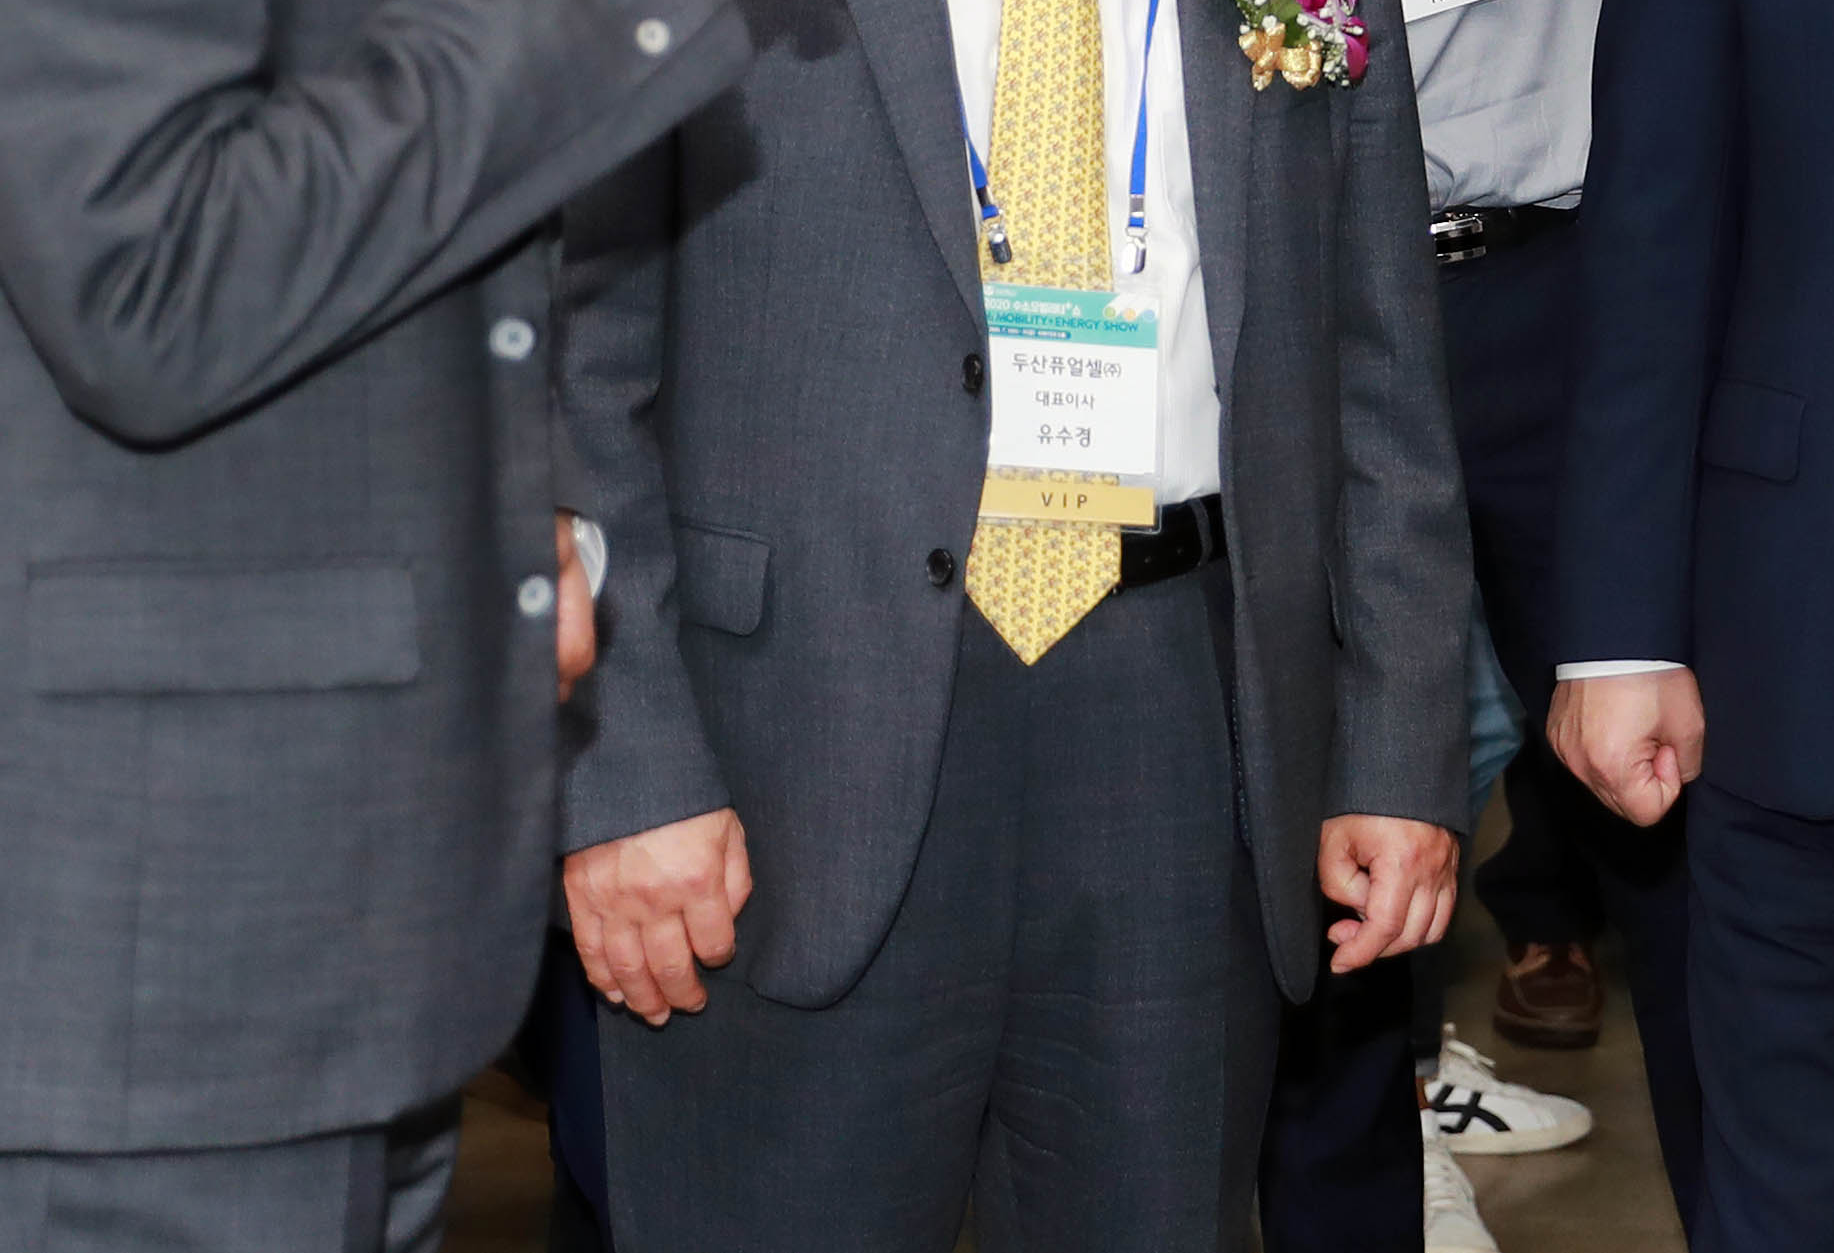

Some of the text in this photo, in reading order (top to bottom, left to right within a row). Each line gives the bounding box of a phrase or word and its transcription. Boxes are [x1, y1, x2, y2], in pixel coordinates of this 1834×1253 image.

[1104, 321, 1139, 333] SHOW
[1036, 390, 1095, 410] 대표이사
[1037, 423, 1091, 448] 유수경
[1041, 492, 1088, 509] VIP
